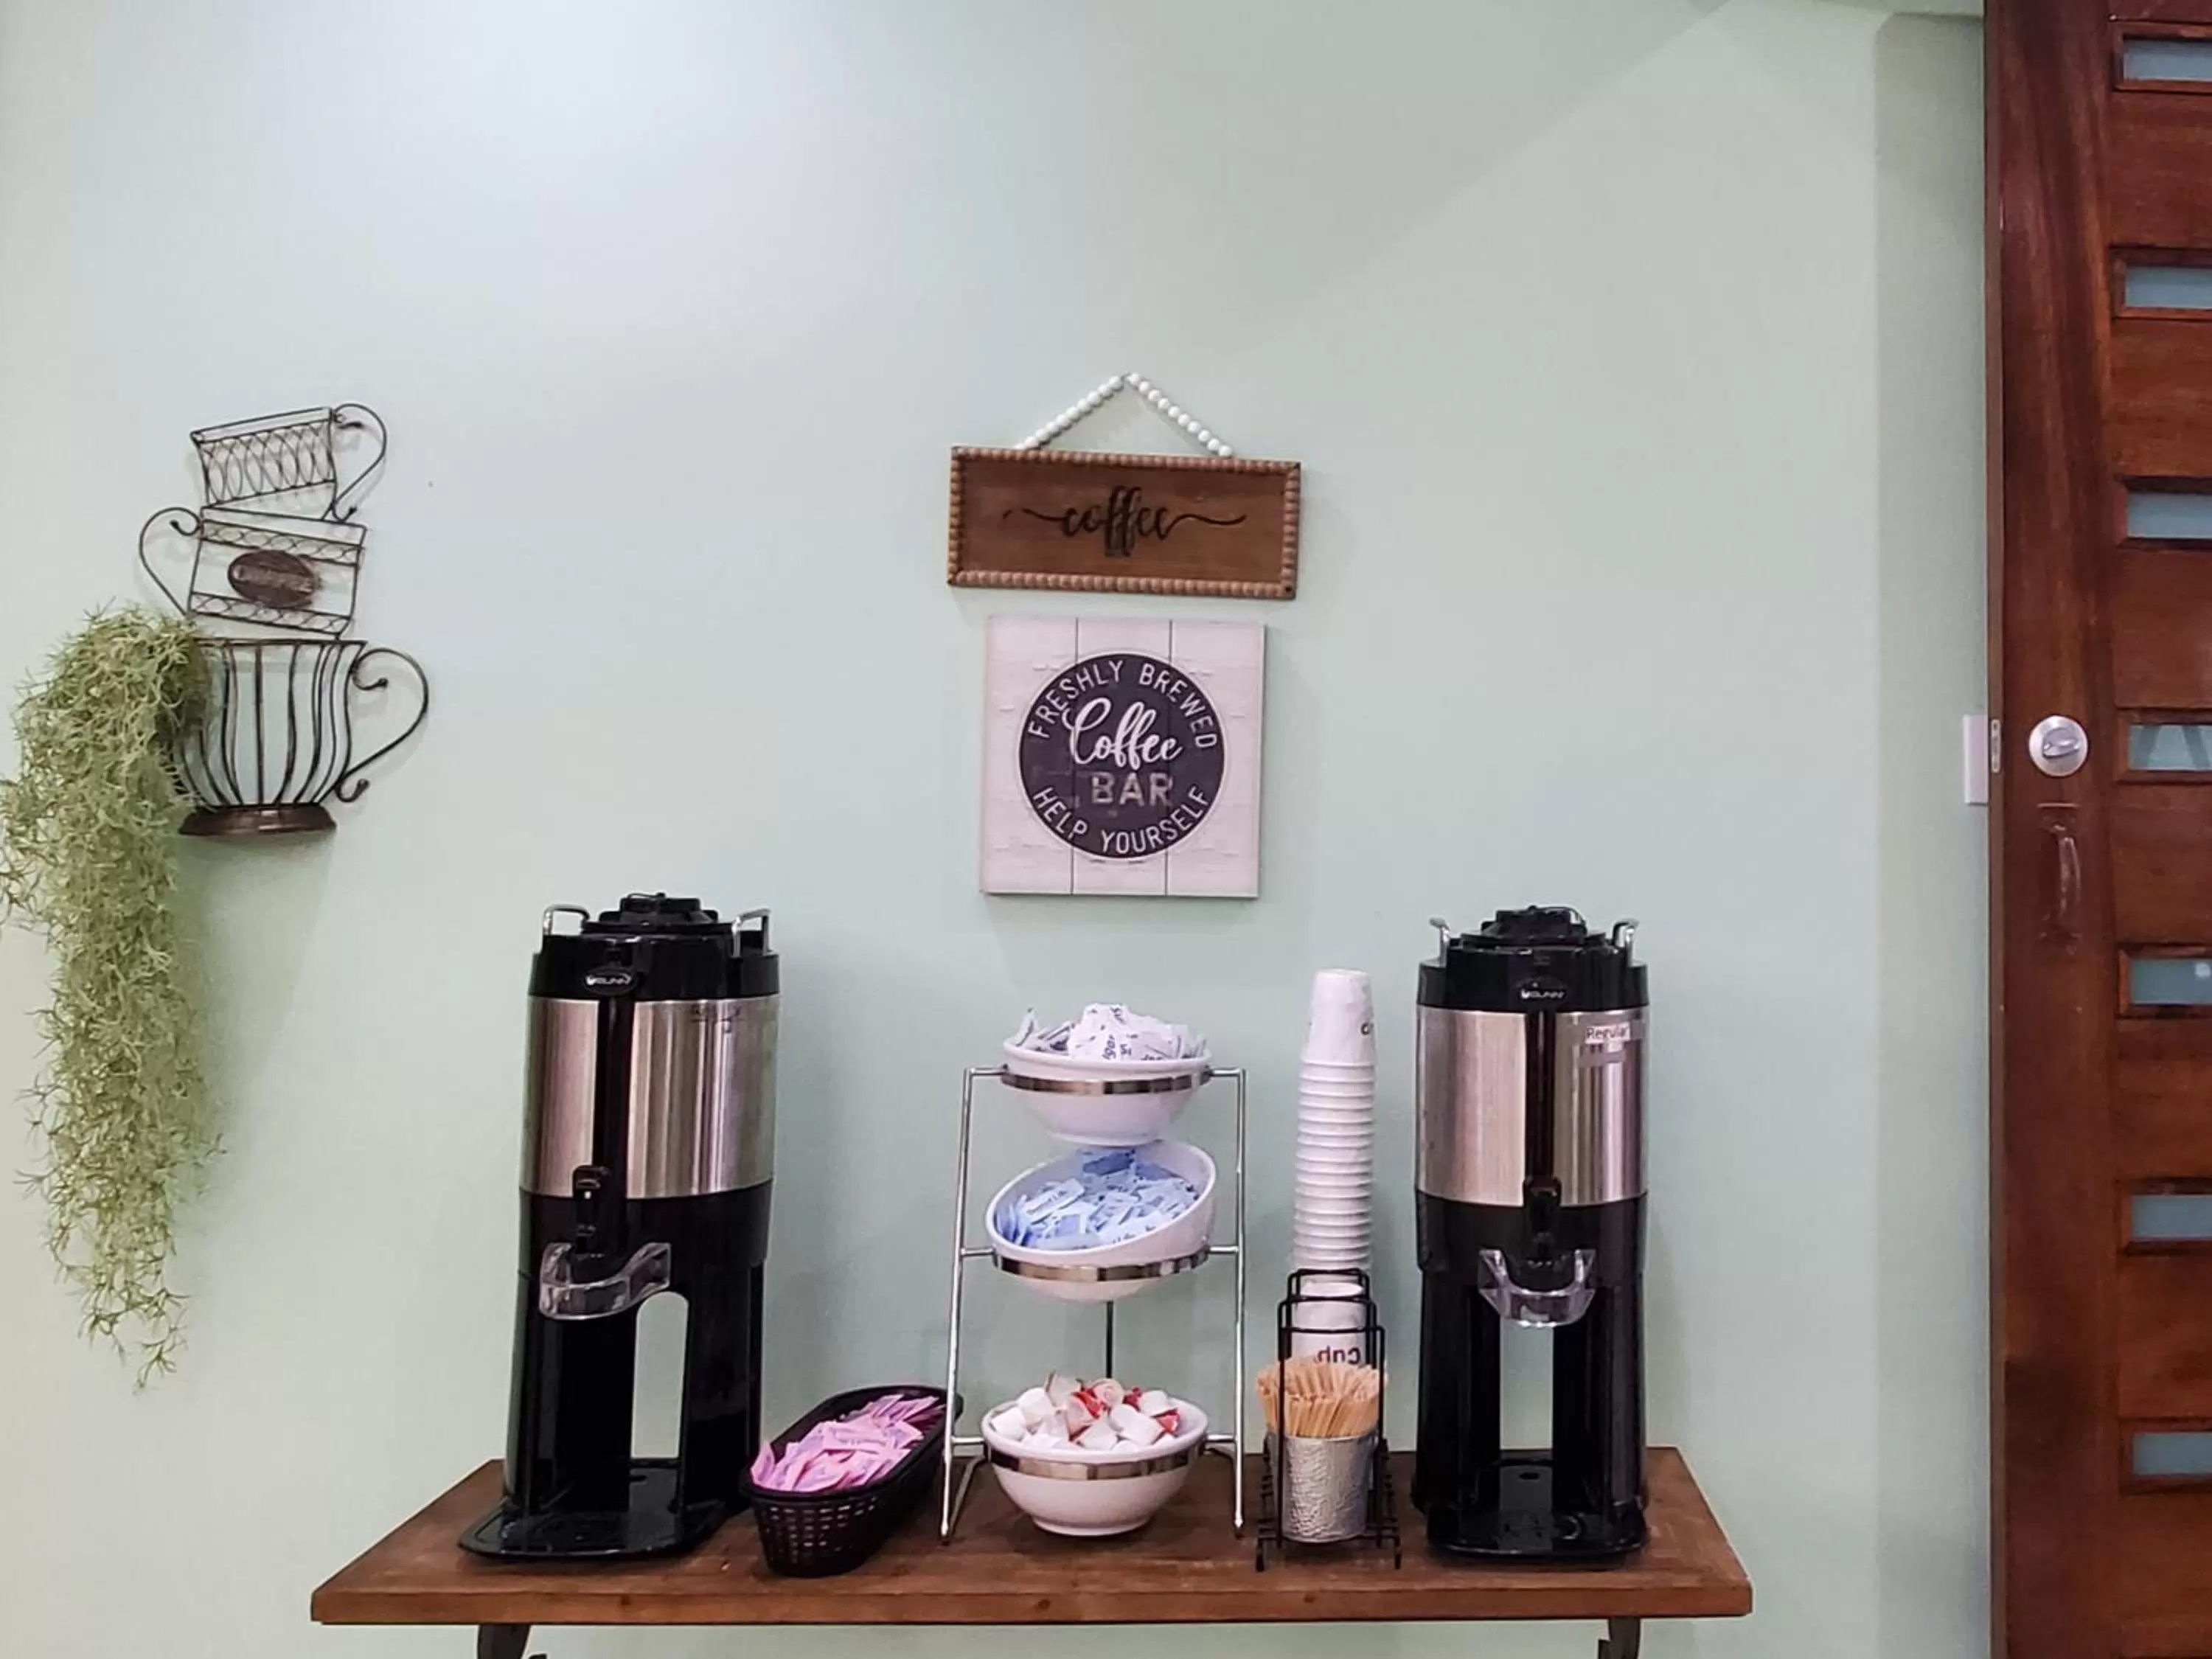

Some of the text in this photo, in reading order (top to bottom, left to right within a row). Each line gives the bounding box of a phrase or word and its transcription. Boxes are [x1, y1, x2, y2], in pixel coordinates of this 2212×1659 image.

[1028, 660, 1217, 748] FRESHLY BREWED
[1062, 698, 1183, 770] Coffee
[1033, 786, 1209, 854] HELP YOURSELF
[1091, 772, 1173, 807] BAR
